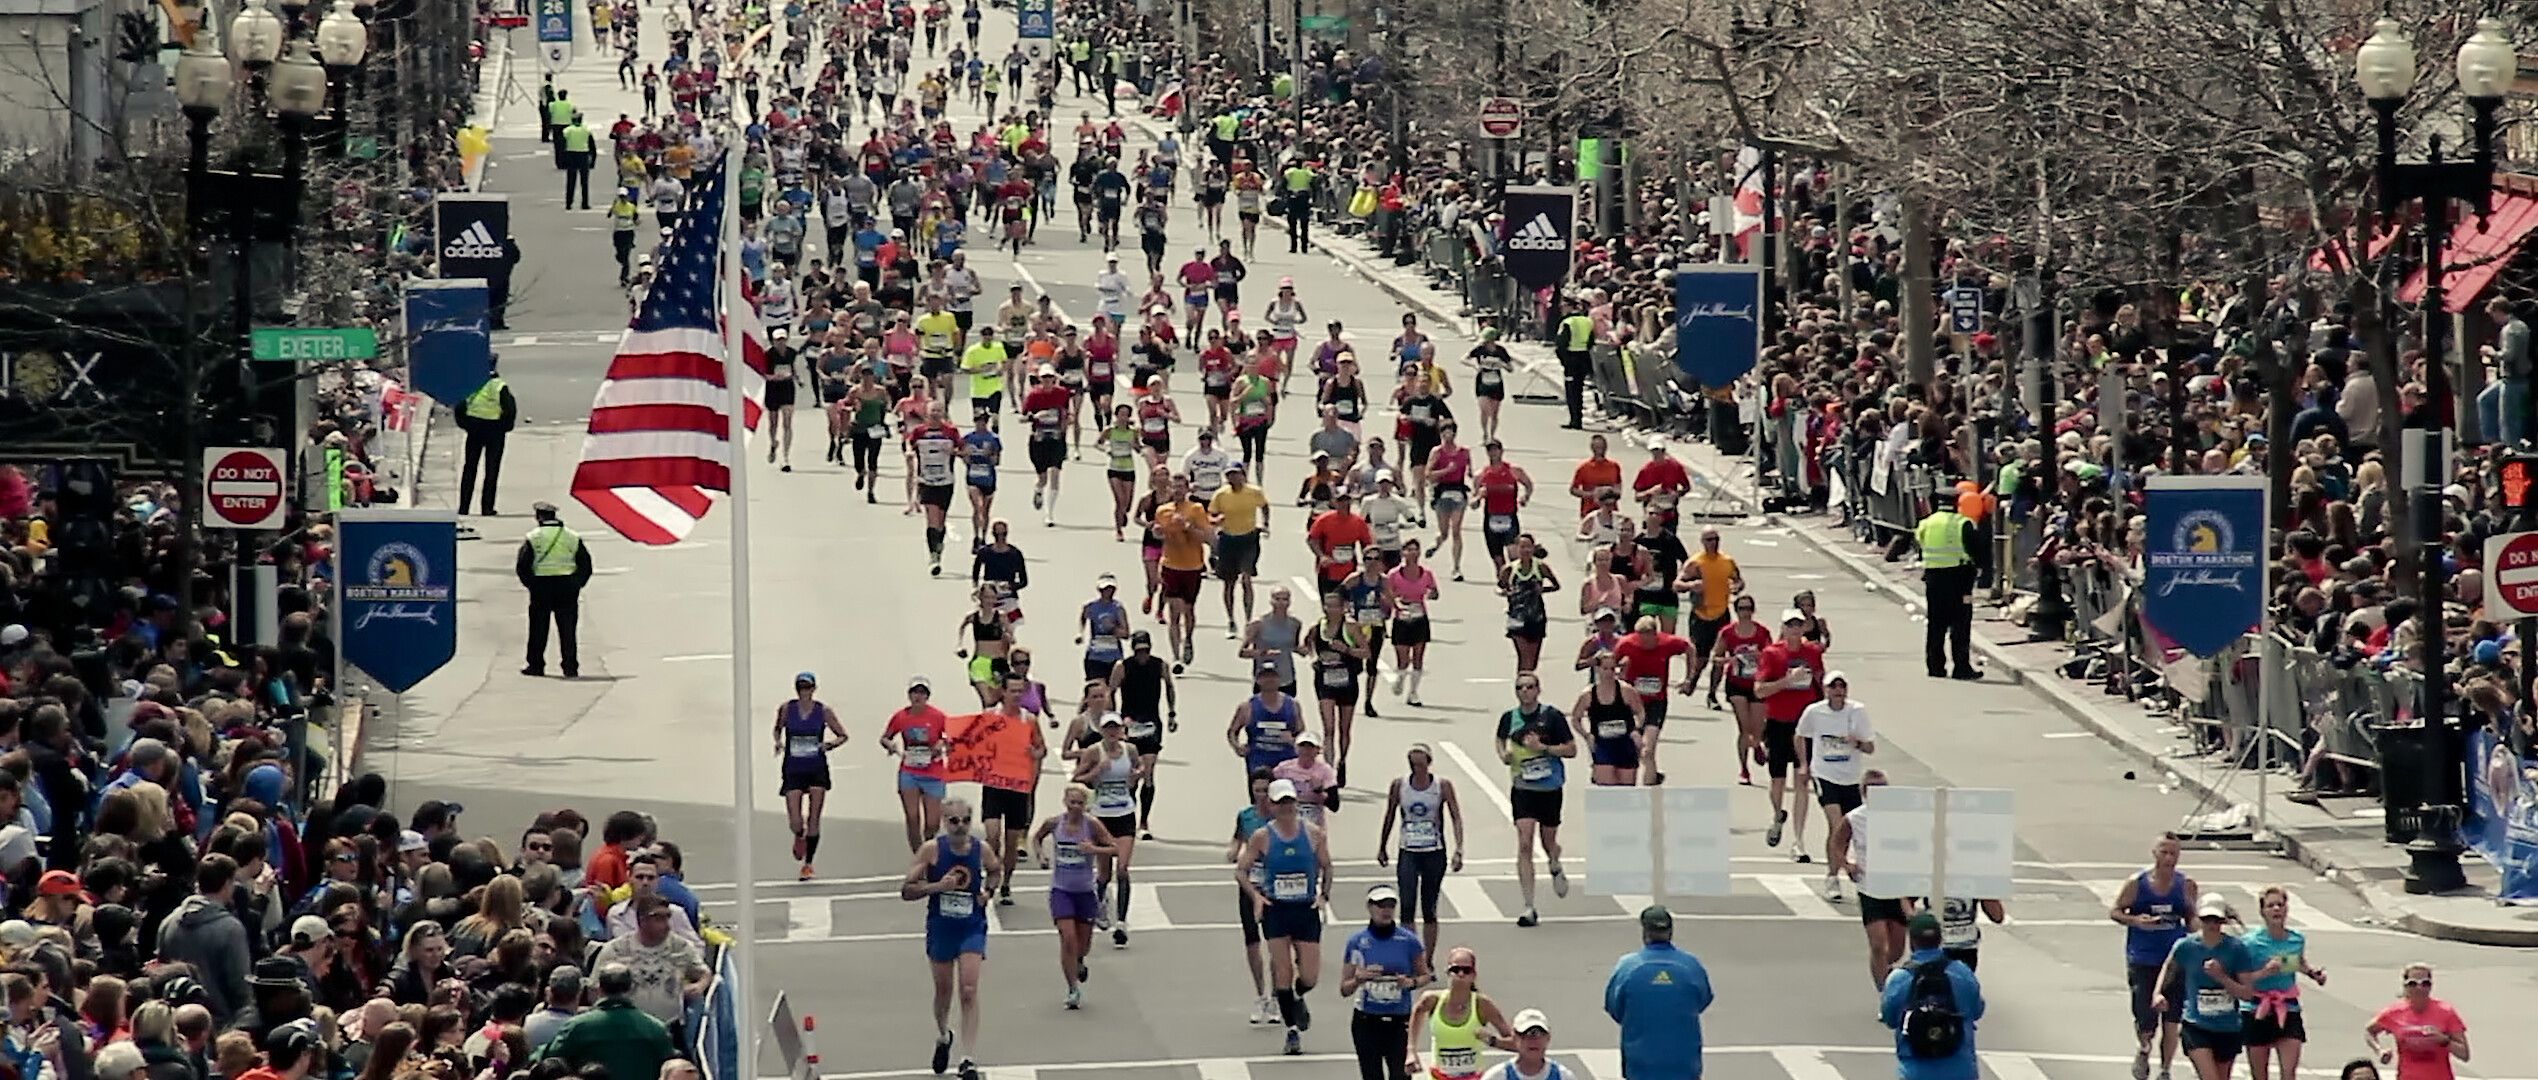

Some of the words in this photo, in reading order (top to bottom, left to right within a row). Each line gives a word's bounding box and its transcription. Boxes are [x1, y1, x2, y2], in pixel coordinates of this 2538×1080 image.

[544, 2, 564, 14] 26
[1509, 235, 1566, 250] adidas
[444, 244, 503, 258] adidas
[280, 336, 344, 358] EXETER
[217, 467, 237, 480] DO
[244, 467, 272, 480] NOT
[222, 497, 267, 509] ENTER
[2152, 555, 2193, 566] BOSTON
[2195, 555, 2254, 566] MARATHON
[2509, 551, 2527, 565] DO
